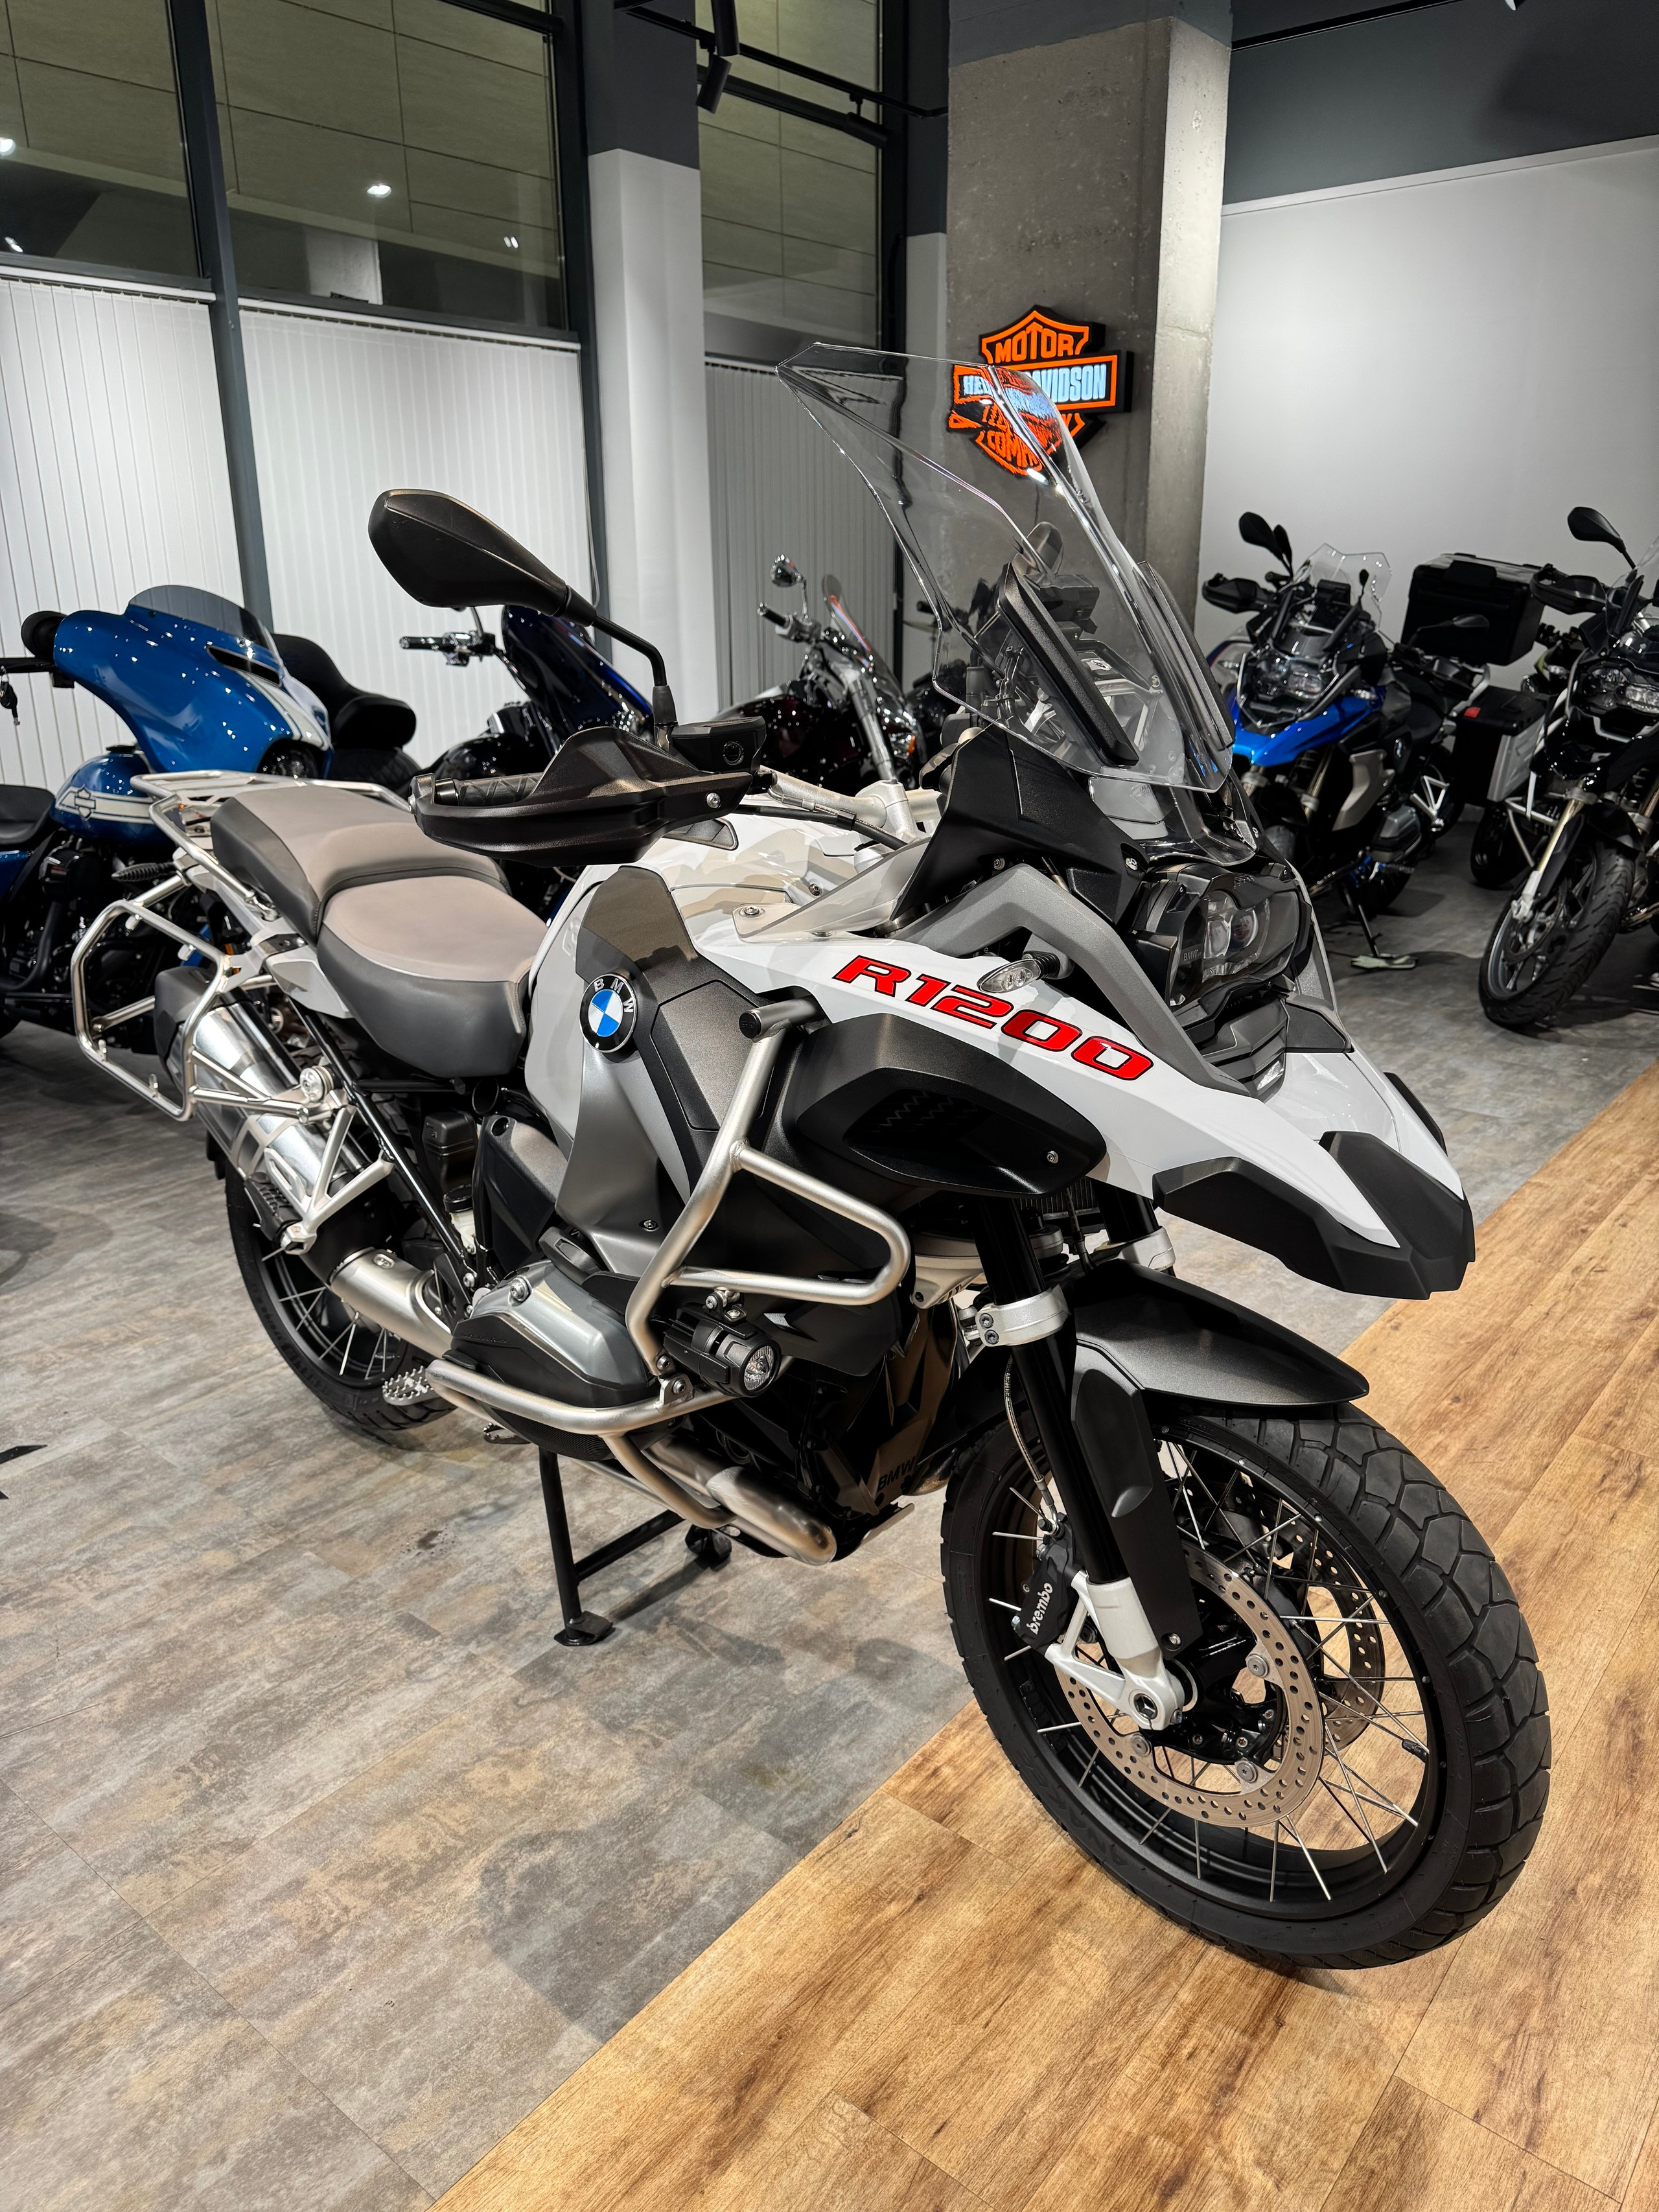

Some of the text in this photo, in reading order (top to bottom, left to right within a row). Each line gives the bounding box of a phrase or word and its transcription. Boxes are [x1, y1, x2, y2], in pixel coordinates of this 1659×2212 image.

[995, 321, 1074, 364] MOTOR
[1183, 949, 1198, 961] BMW
[594, 978, 634, 1013] BMW
[832, 955, 1154, 1080] R1200
[877, 1456, 916, 1492] BMW
[1027, 1583, 1053, 1635] brembo
